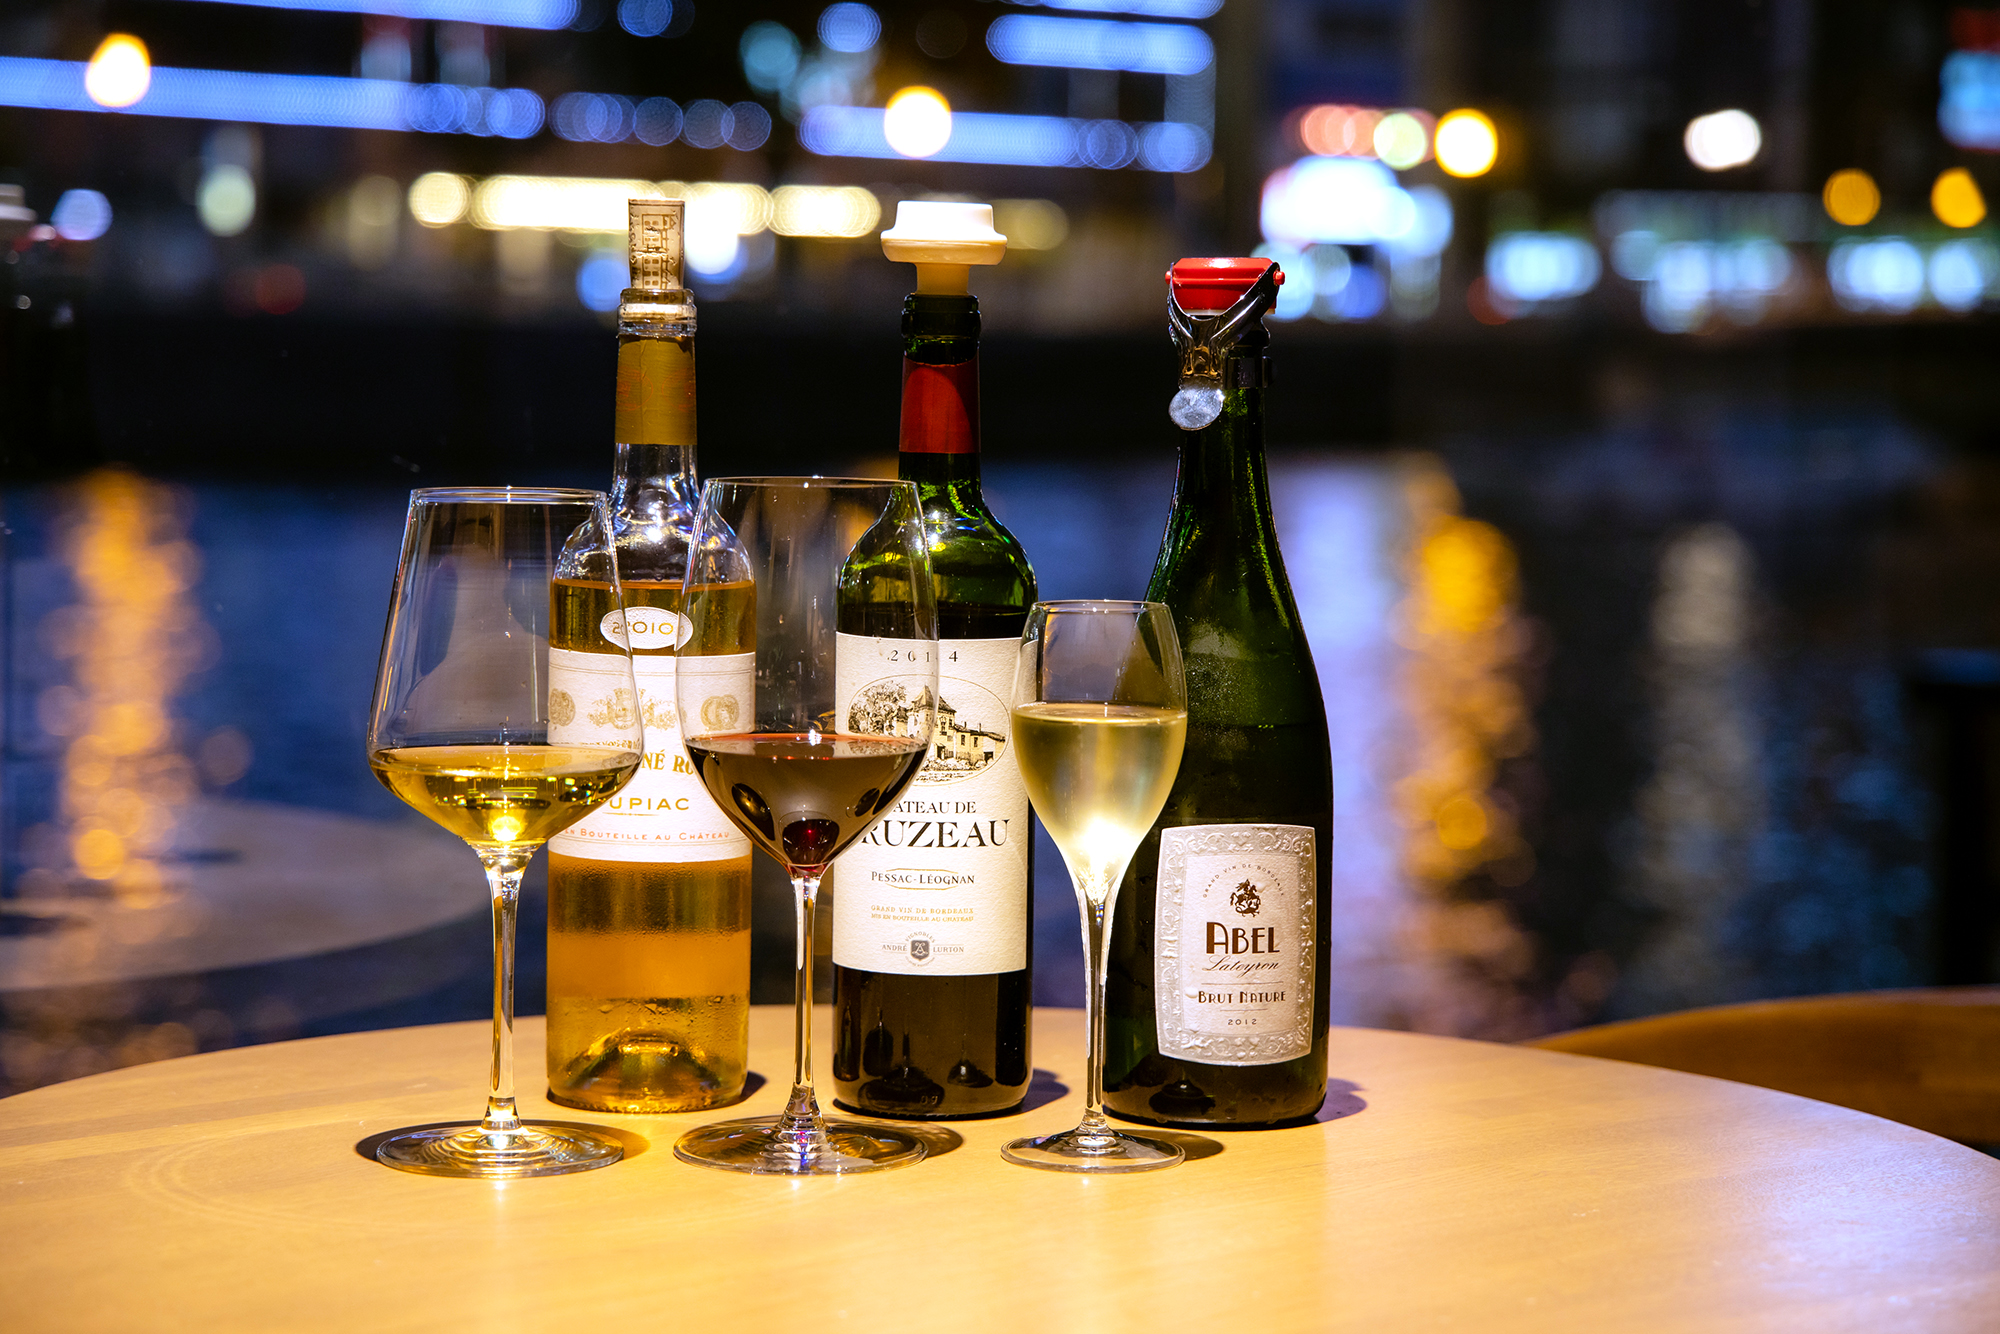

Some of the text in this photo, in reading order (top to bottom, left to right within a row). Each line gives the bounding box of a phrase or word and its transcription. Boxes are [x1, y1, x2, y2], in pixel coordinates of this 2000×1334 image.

[890, 650, 959, 663] 2014
[609, 797, 690, 811] UPIAC
[893, 801, 977, 814] ATEAU DE
[580, 828, 648, 840] BOUTEILLE
[655, 833, 671, 841] AU
[861, 819, 1011, 848] RUZEAU
[871, 871, 975, 885] PESSAC-LÉOGNAN
[871, 905, 896, 913] GRAND
[930, 907, 974, 915] BORDEAUX
[1206, 921, 1280, 955] ABEL
[881, 943, 908, 952] ANDRÉ
[1198, 990, 1287, 1004] BRUT NATURE
[1227, 1018, 1257, 1026] 2012
